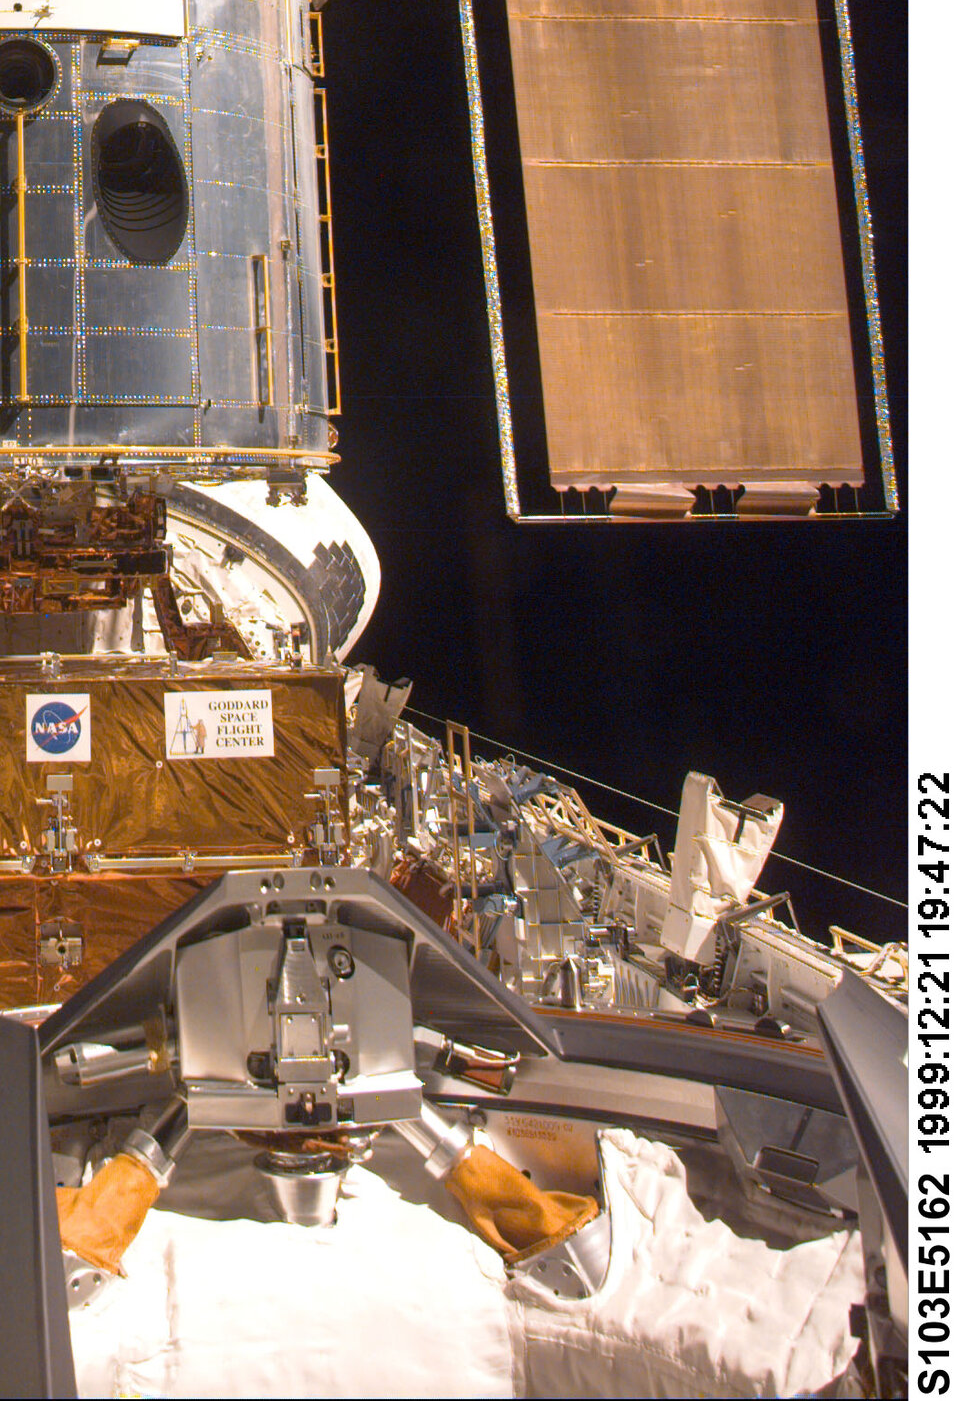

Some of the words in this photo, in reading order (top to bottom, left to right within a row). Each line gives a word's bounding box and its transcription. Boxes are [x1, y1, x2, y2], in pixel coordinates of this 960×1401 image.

[208, 700, 269, 711] GODDARD
[220, 712, 258, 723] SPACE
[35, 722, 79, 734] NASA
[217, 724, 262, 735] FLIGHT
[216, 736, 264, 747] CENTER
